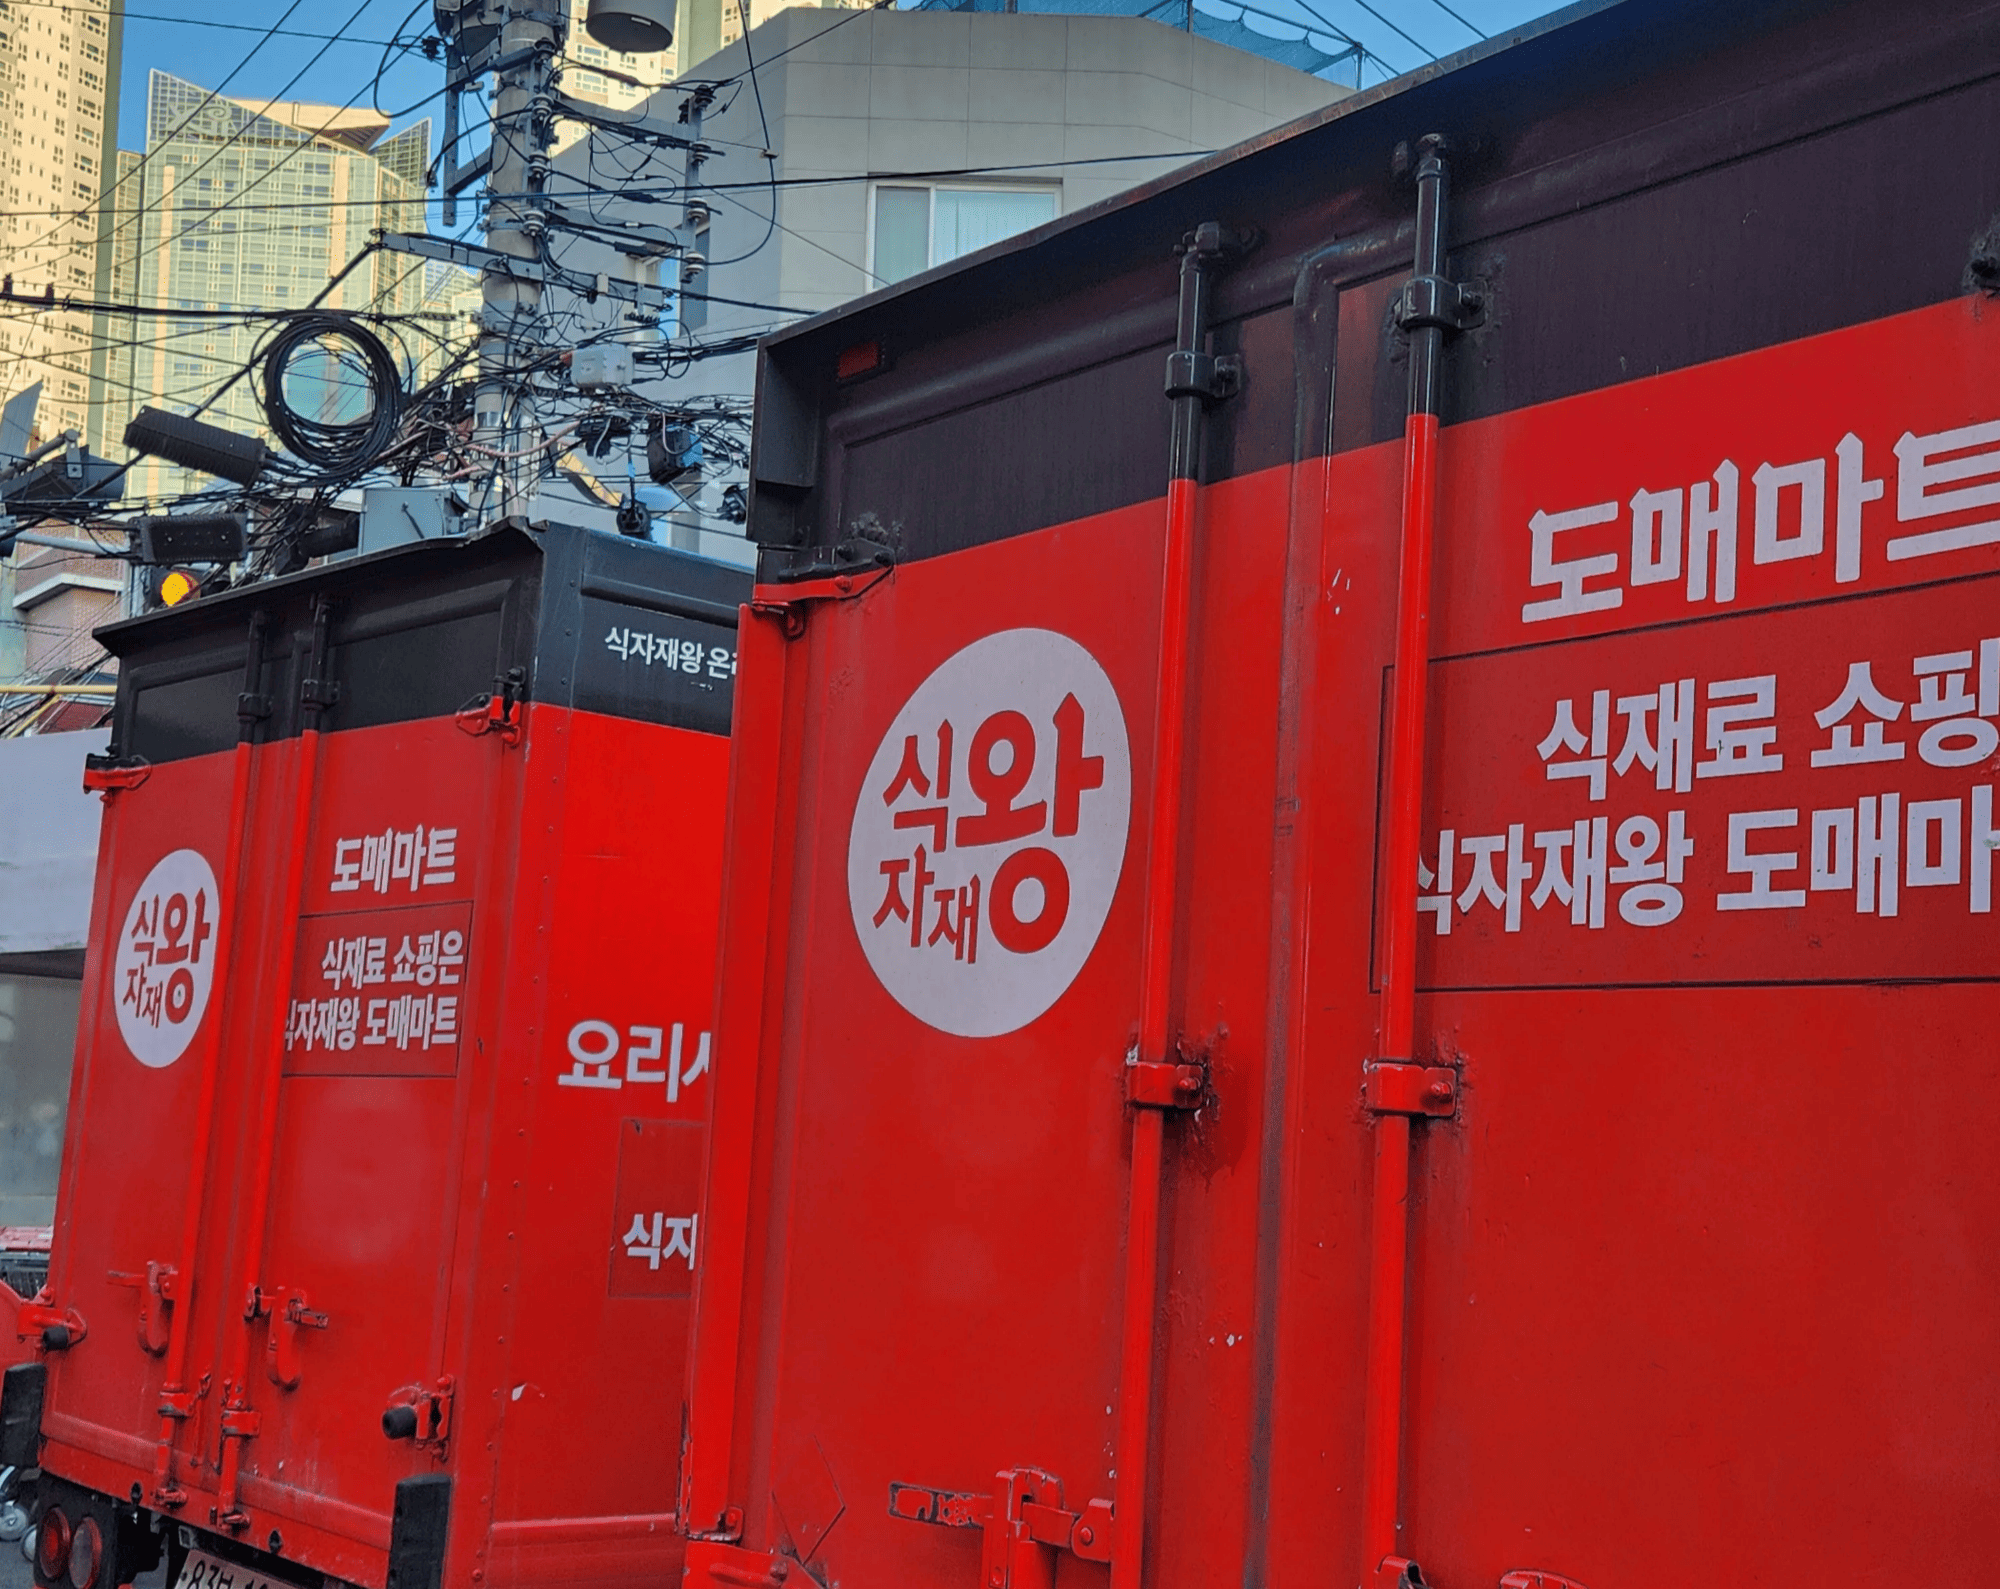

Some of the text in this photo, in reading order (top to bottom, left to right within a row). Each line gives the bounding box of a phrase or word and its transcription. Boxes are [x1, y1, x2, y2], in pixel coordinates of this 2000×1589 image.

[1521, 419, 2000, 623] 도매마트
[604, 626, 704, 674] 식자재왕
[1536, 675, 1783, 801] 식재료
[330, 824, 458, 894] 도매마트
[321, 930, 464, 990] 식재료 쇼핑은
[362, 994, 458, 1051] 도매마트
